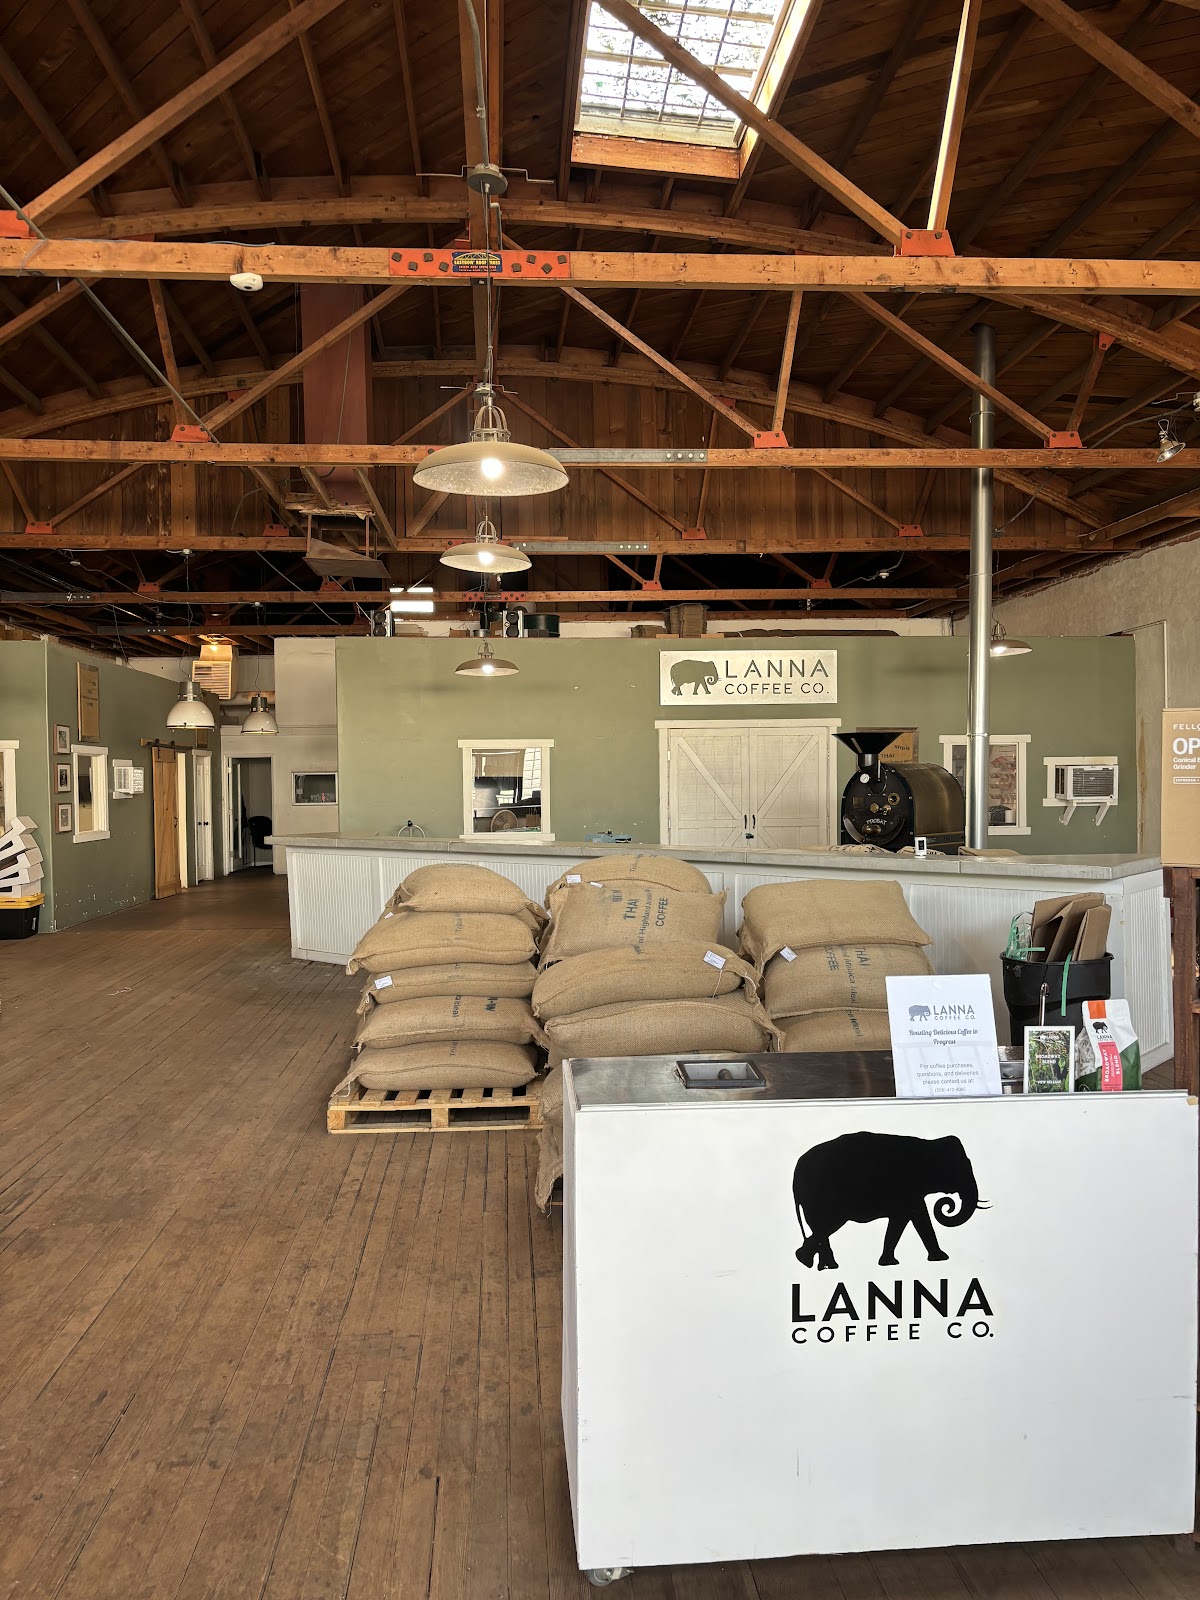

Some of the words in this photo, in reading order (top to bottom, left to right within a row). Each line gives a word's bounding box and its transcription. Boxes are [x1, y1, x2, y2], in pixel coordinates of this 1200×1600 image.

[725, 659, 829, 679] LANNA
[725, 683, 793, 695] COFFEE
[800, 683, 829, 694] CO.
[623, 898, 640, 921] THAI
[655, 897, 669, 927] COFFEE
[855, 946, 871, 967] THAI
[933, 1004, 975, 1016] LANNA
[908, 1029, 932, 1037] Roasting
[957, 1028, 973, 1036] Coffee
[932, 1038, 957, 1046] Progress
[1102, 1048, 1110, 1083] BROADWAY
[791, 1277, 995, 1323] LANNA
[791, 1323, 920, 1344] COFFEE
[946, 1321, 994, 1339] CO.
